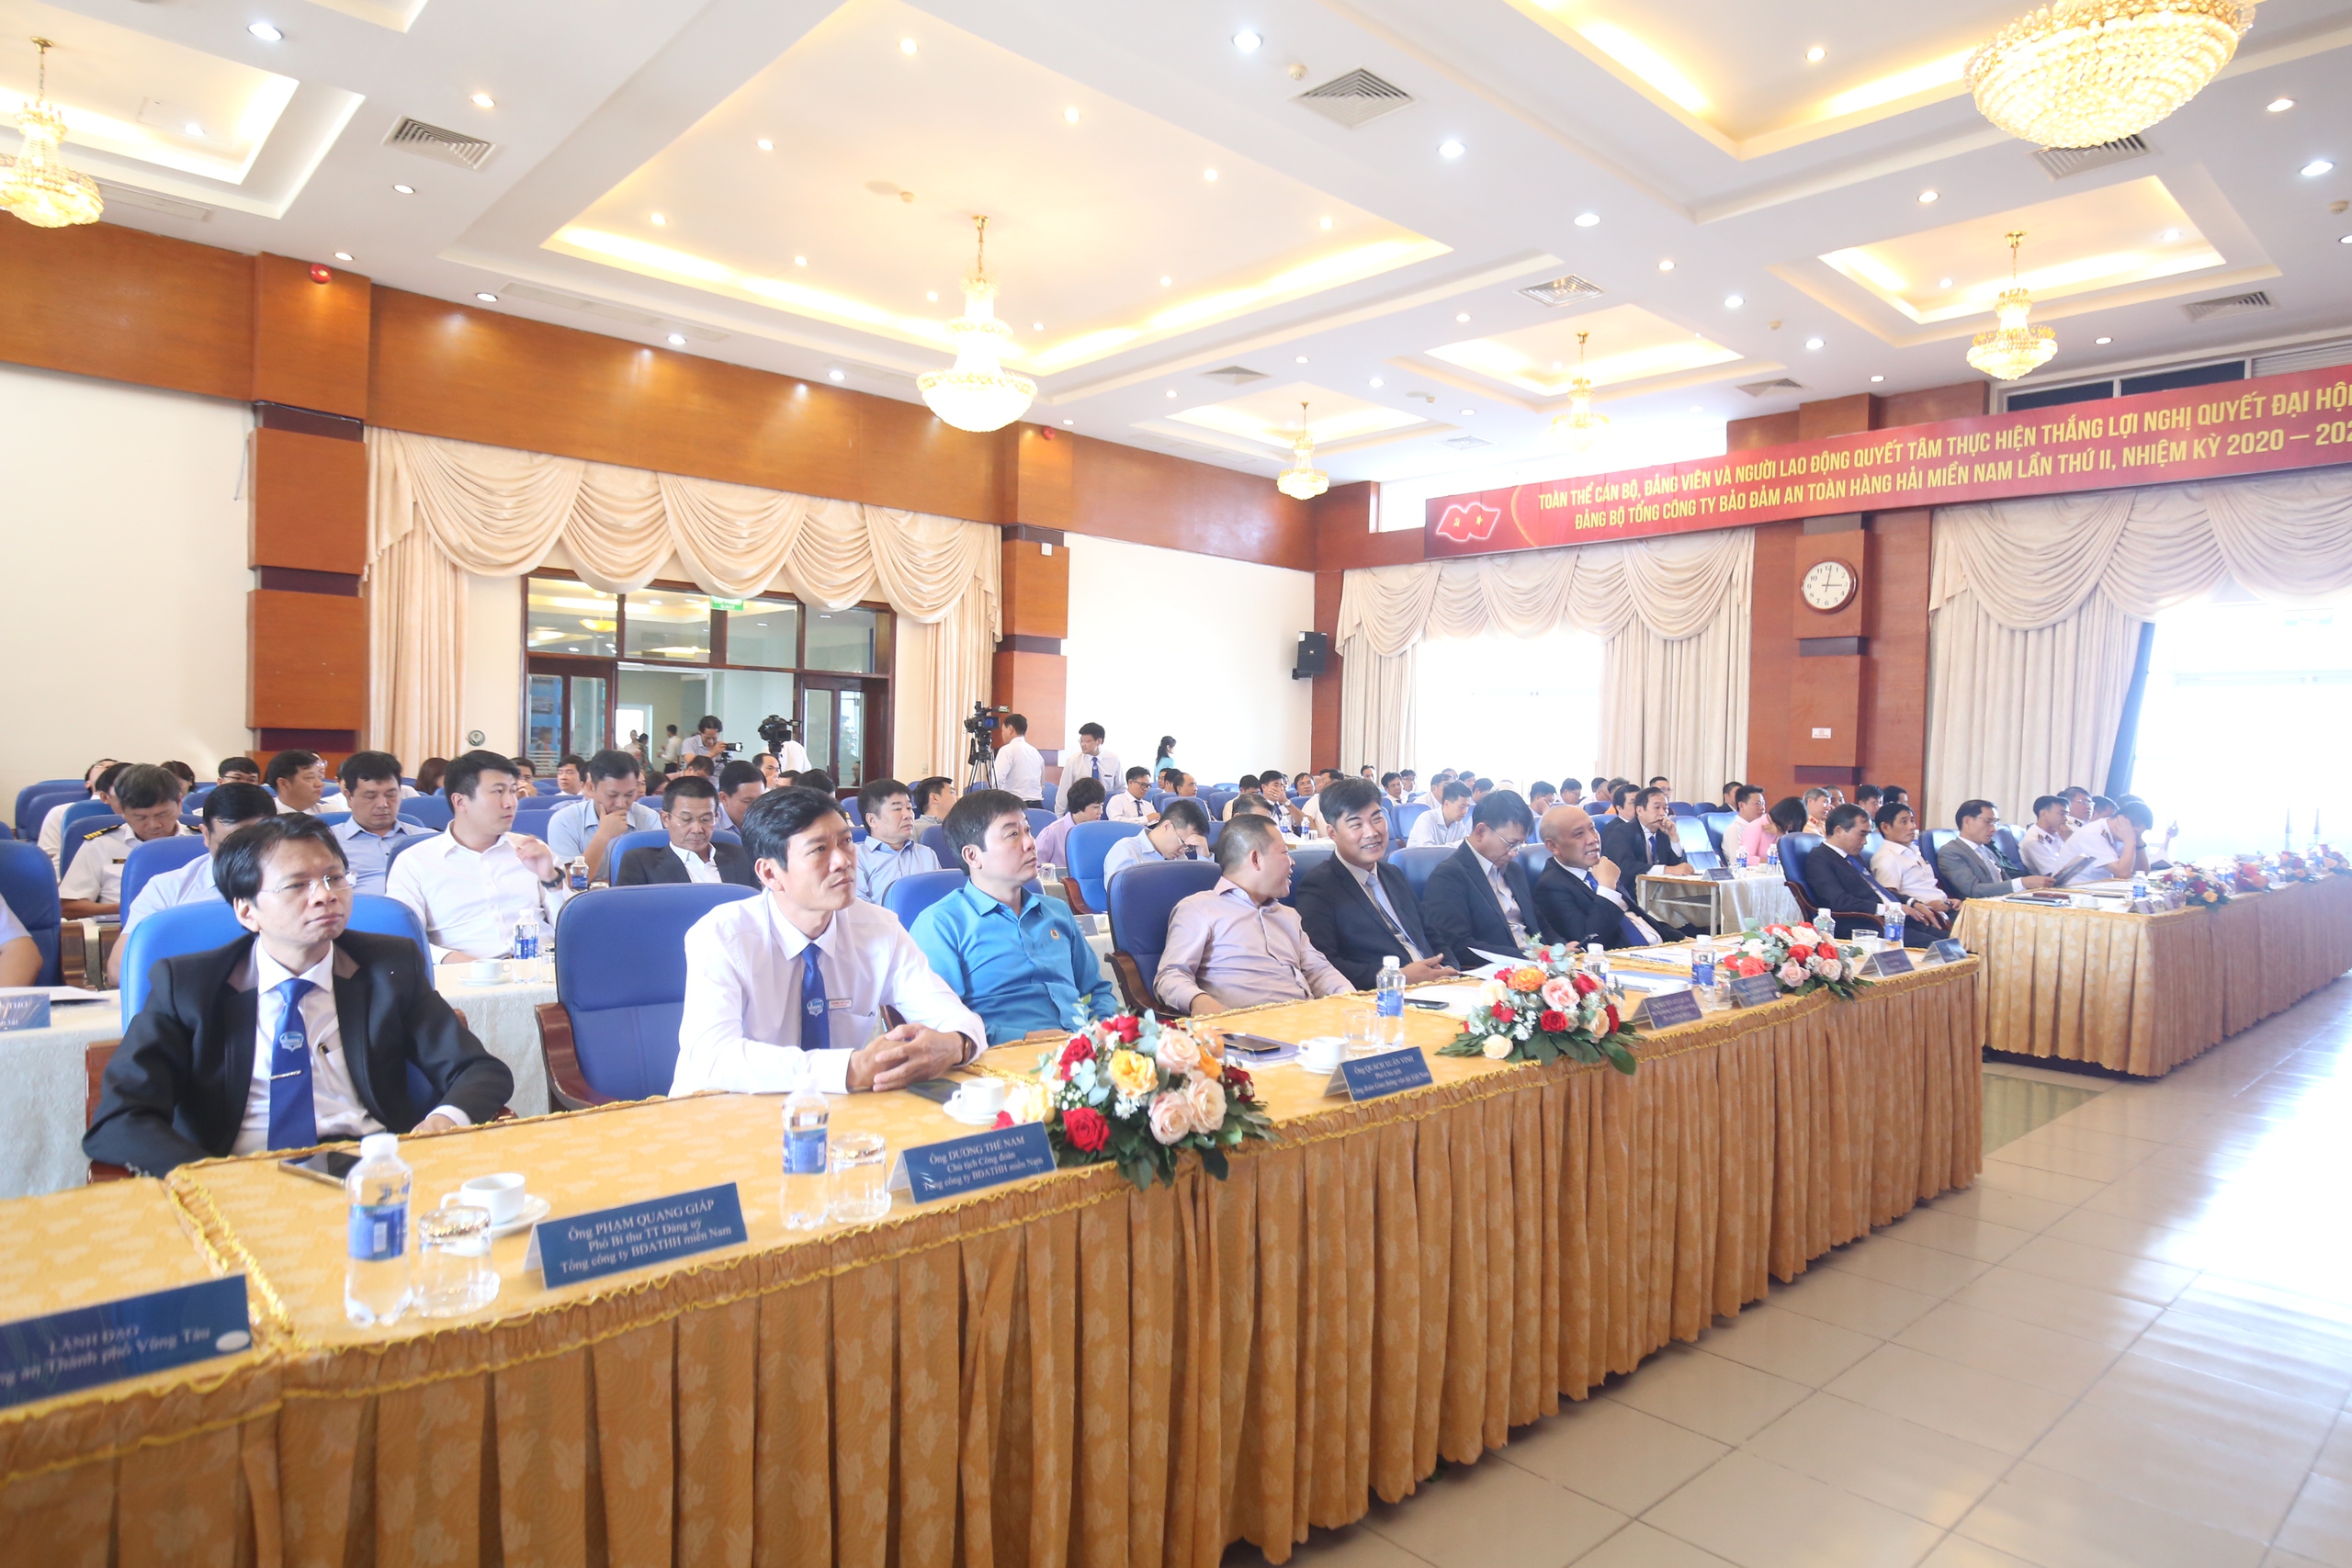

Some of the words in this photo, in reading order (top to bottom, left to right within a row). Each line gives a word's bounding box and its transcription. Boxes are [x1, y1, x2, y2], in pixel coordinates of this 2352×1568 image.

[1539, 490, 1567, 510] TOÀN
[1570, 481, 1595, 505] THỂ
[1595, 483, 1619, 502] CÁN
[1622, 479, 1641, 501] BỘ,
[1645, 474, 1678, 497] ĐẢNG
[1681, 469, 1711, 491] VIÊN
[1714, 465, 1732, 487] VÀ
[1736, 459, 1776, 483] NGƯỜI
[1781, 457, 1806, 478] LAO
[1810, 450, 1849, 475] ĐỘNG
[1854, 439, 1904, 468] QUYẾT
[1907, 437, 1942, 461] TÂM
[1947, 432, 1990, 457] THỰC
[1996, 424, 2036, 452] HIỆN
[2041, 414, 2103, 445] THẮNG
[2109, 412, 2138, 438] LỢI
[2143, 406, 2191, 432] NGHỊ
[2198, 391, 2267, 426] QUYẾT
[2271, 390, 2309, 418] ĐẠI
[1575, 509, 1606, 530] ĐẢNG
[1610, 506, 1625, 527] BỘ
[1628, 500, 1659, 524] TỔNG
[1663, 500, 1696, 520] CÔNG
[1700, 496, 1716, 514] TY
[1720, 489, 1746, 512] BẢO
[1749, 485, 1780, 508] ĐẢM
[1784, 486, 1804, 504] AN
[1807, 479, 1845, 502] TOÀN
[1850, 474, 1892, 496] HÀNG
[1896, 466, 1922, 491] HẢI
[1928, 461, 1969, 488] MIỀN
[1973, 460, 2012, 482] NAM
[2018, 452, 2052, 478] LẦN
[2058, 447, 2095, 474] THỨ
[2100, 449, 2116, 471] II,
[2122, 439, 2187, 468] NHIỆM
[2193, 433, 2222, 459] KỲ
[2227, 429, 2284, 456] 2020
[930, 1152, 947, 1165] Ông
[948, 1145, 983, 1160] DƯƠNG
[984, 1139, 1003, 1152] THẾ
[1003, 1136, 1024, 1148] NAM
[978, 1156, 998, 1166] Công
[944, 1176, 963, 1186] công
[1026, 1157, 1043, 1166] Nam
[569, 1225, 593, 1241] Ông
[595, 1216, 634, 1235] PHẠM
[637, 1205, 683, 1226] QUANG
[685, 1198, 714, 1214] GIÁP
[560, 1258, 589, 1273] Tổng
[592, 1253, 616, 1267] công
[619, 1250, 628, 1261] ty
[684, 1230, 707, 1244] miền
[708, 1226, 731, 1238] Nam
[589, 1237, 608, 1252] Phó
[612, 1235, 623, 1247] Bí
[626, 1232, 642, 1243] thư
[645, 1226, 659, 1238] TT
